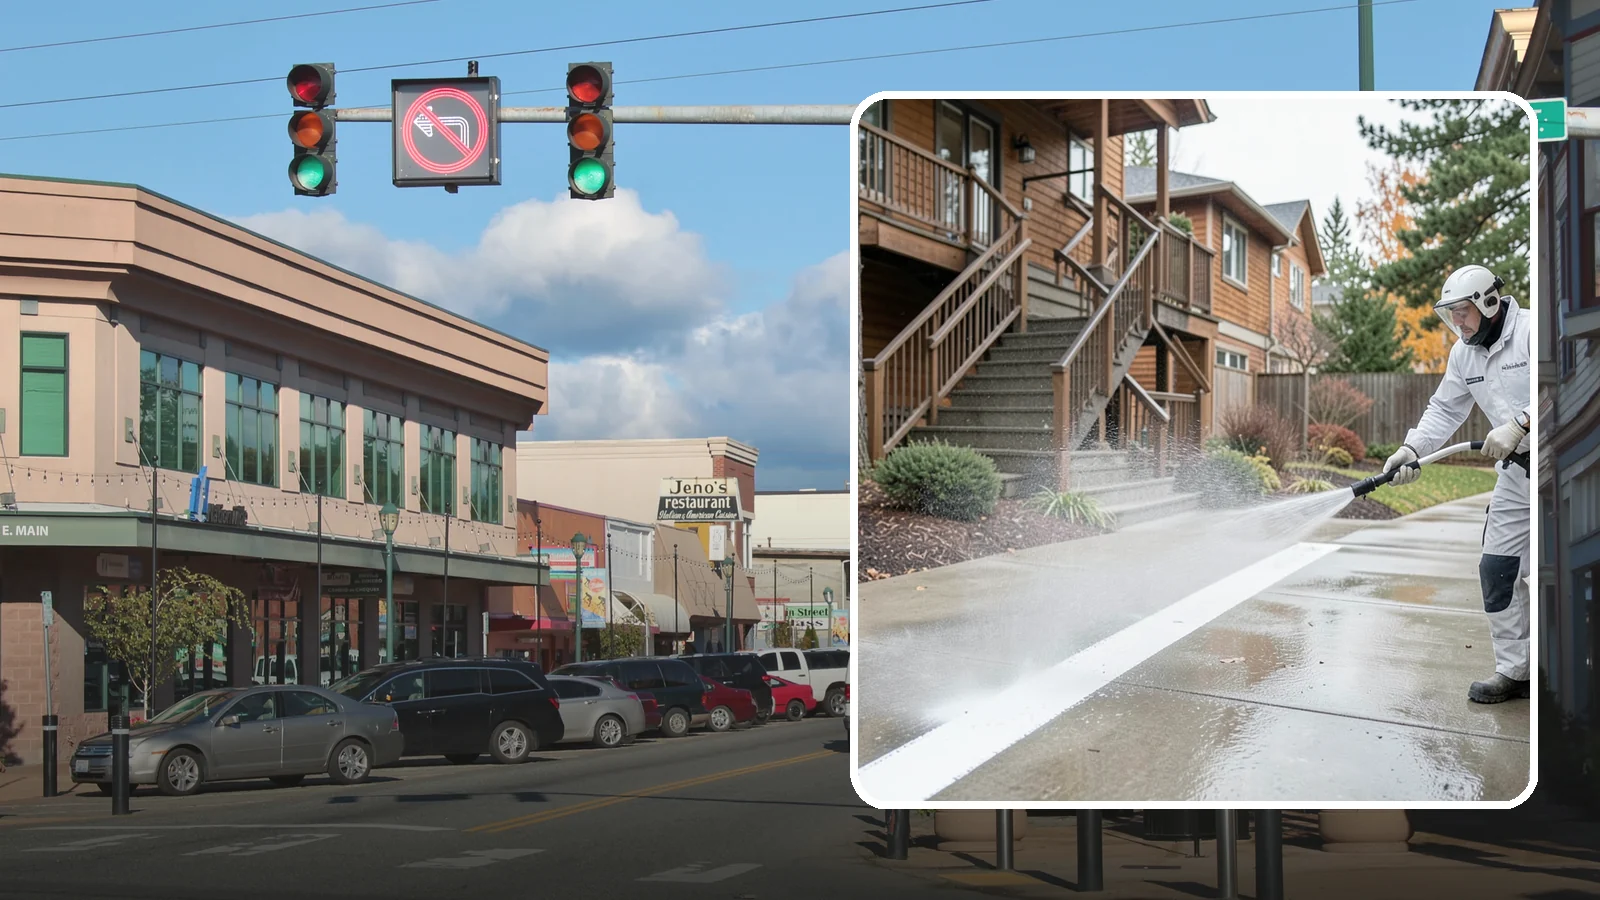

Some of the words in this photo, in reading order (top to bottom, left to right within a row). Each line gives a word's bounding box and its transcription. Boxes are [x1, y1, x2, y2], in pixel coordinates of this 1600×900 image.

[670, 480, 727, 494] Jeno's
[665, 496, 731, 509] restaurant
[658, 510, 681, 519] Italian
[686, 510, 714, 519] American
[715, 510, 737, 519] Cuisine
[2, 525, 13, 536] E.
[15, 525, 49, 536] MAIN
[797, 607, 828, 617] Street
